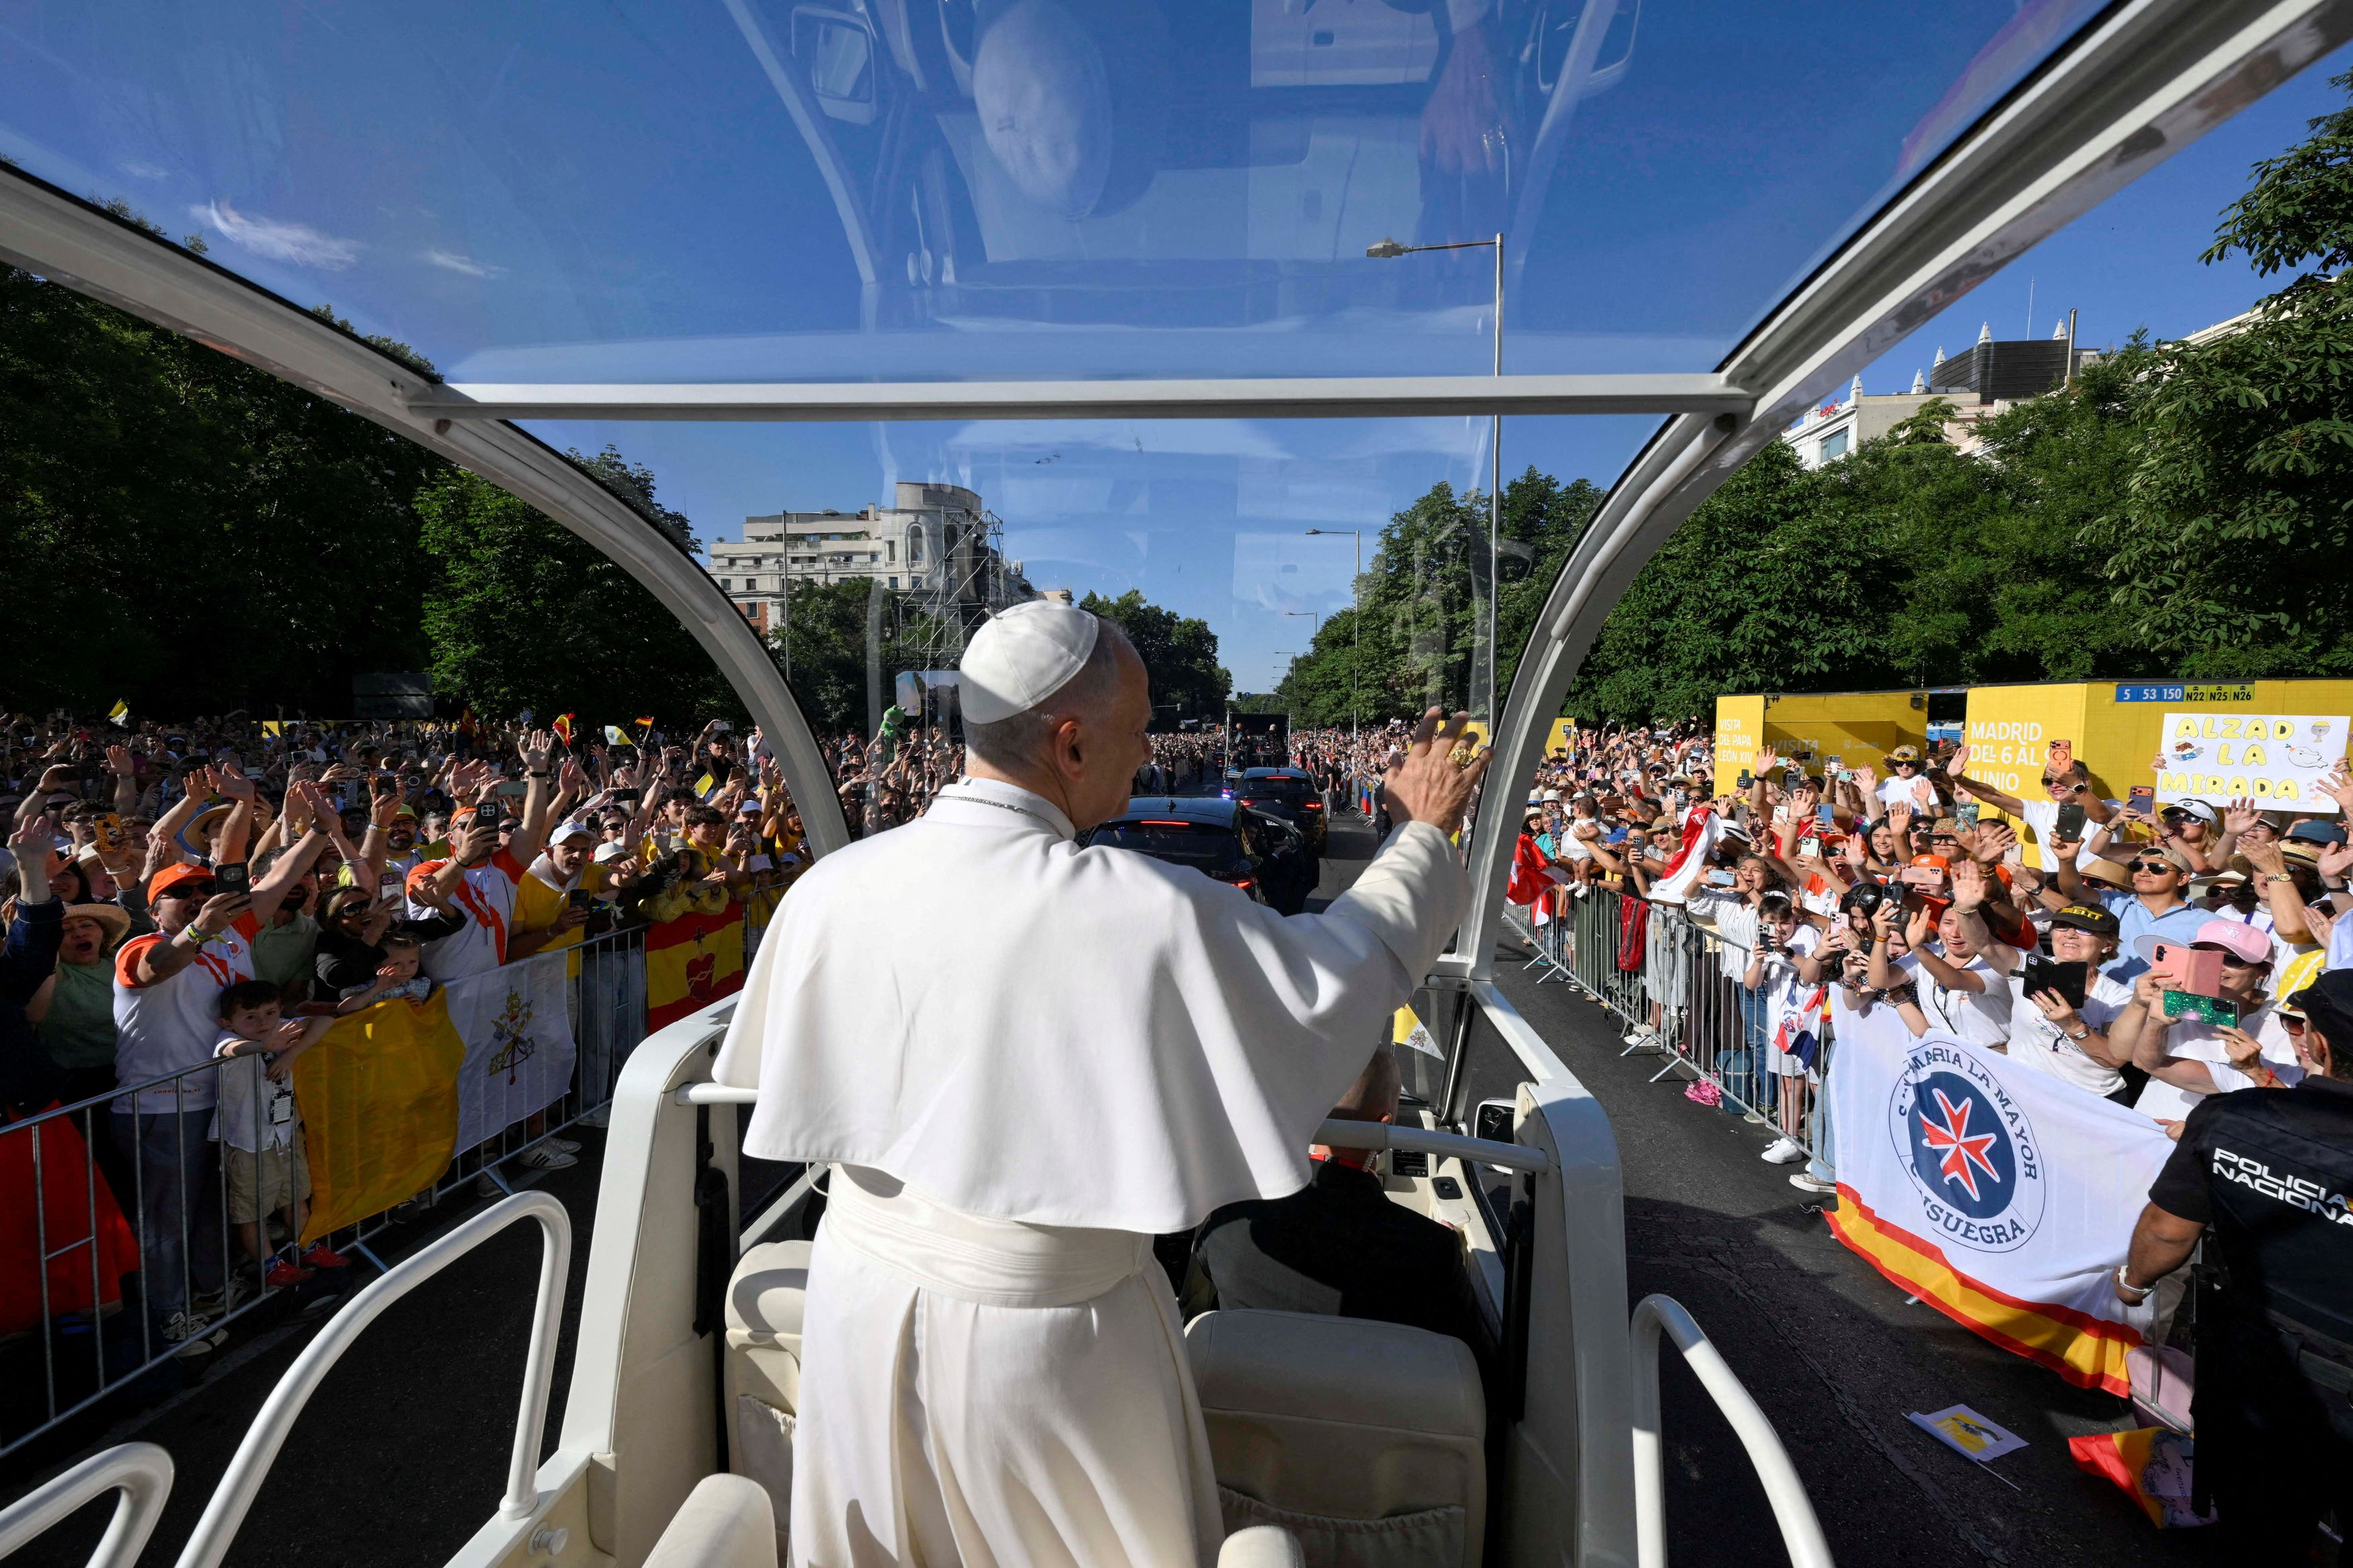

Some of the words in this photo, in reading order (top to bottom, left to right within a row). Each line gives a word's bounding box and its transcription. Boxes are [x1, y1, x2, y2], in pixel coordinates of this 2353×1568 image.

[2123, 689, 2130, 700] 5
[2143, 688, 2157, 700] 53
[2163, 688, 2182, 700] 150
[2186, 692, 2204, 701] N22
[2210, 692, 2228, 701] N25
[2233, 691, 2251, 701] N26
[1720, 719, 1741, 731] VISITA
[1970, 722, 2042, 745] MADRID
[2175, 717, 2295, 741] ALZAD
[1719, 734, 1730, 746] DEL
[1732, 734, 1752, 747] PAPA
[1772, 739, 1819, 752] VISITA
[1718, 747, 1737, 762] LEÓN
[1739, 751, 1753, 764] XIV
[1970, 744, 1997, 764] DEL
[2001, 745, 2012, 764] 6
[2015, 747, 2040, 766] AL
[2217, 743, 2268, 766] LA
[2160, 772, 2299, 800] MIRADA
[2218, 925, 2244, 941] NY
[1968, 1060, 1990, 1089] LA
[1994, 1087, 2038, 1180] MAYOR
[2214, 1147, 2350, 1211] POLICIA
